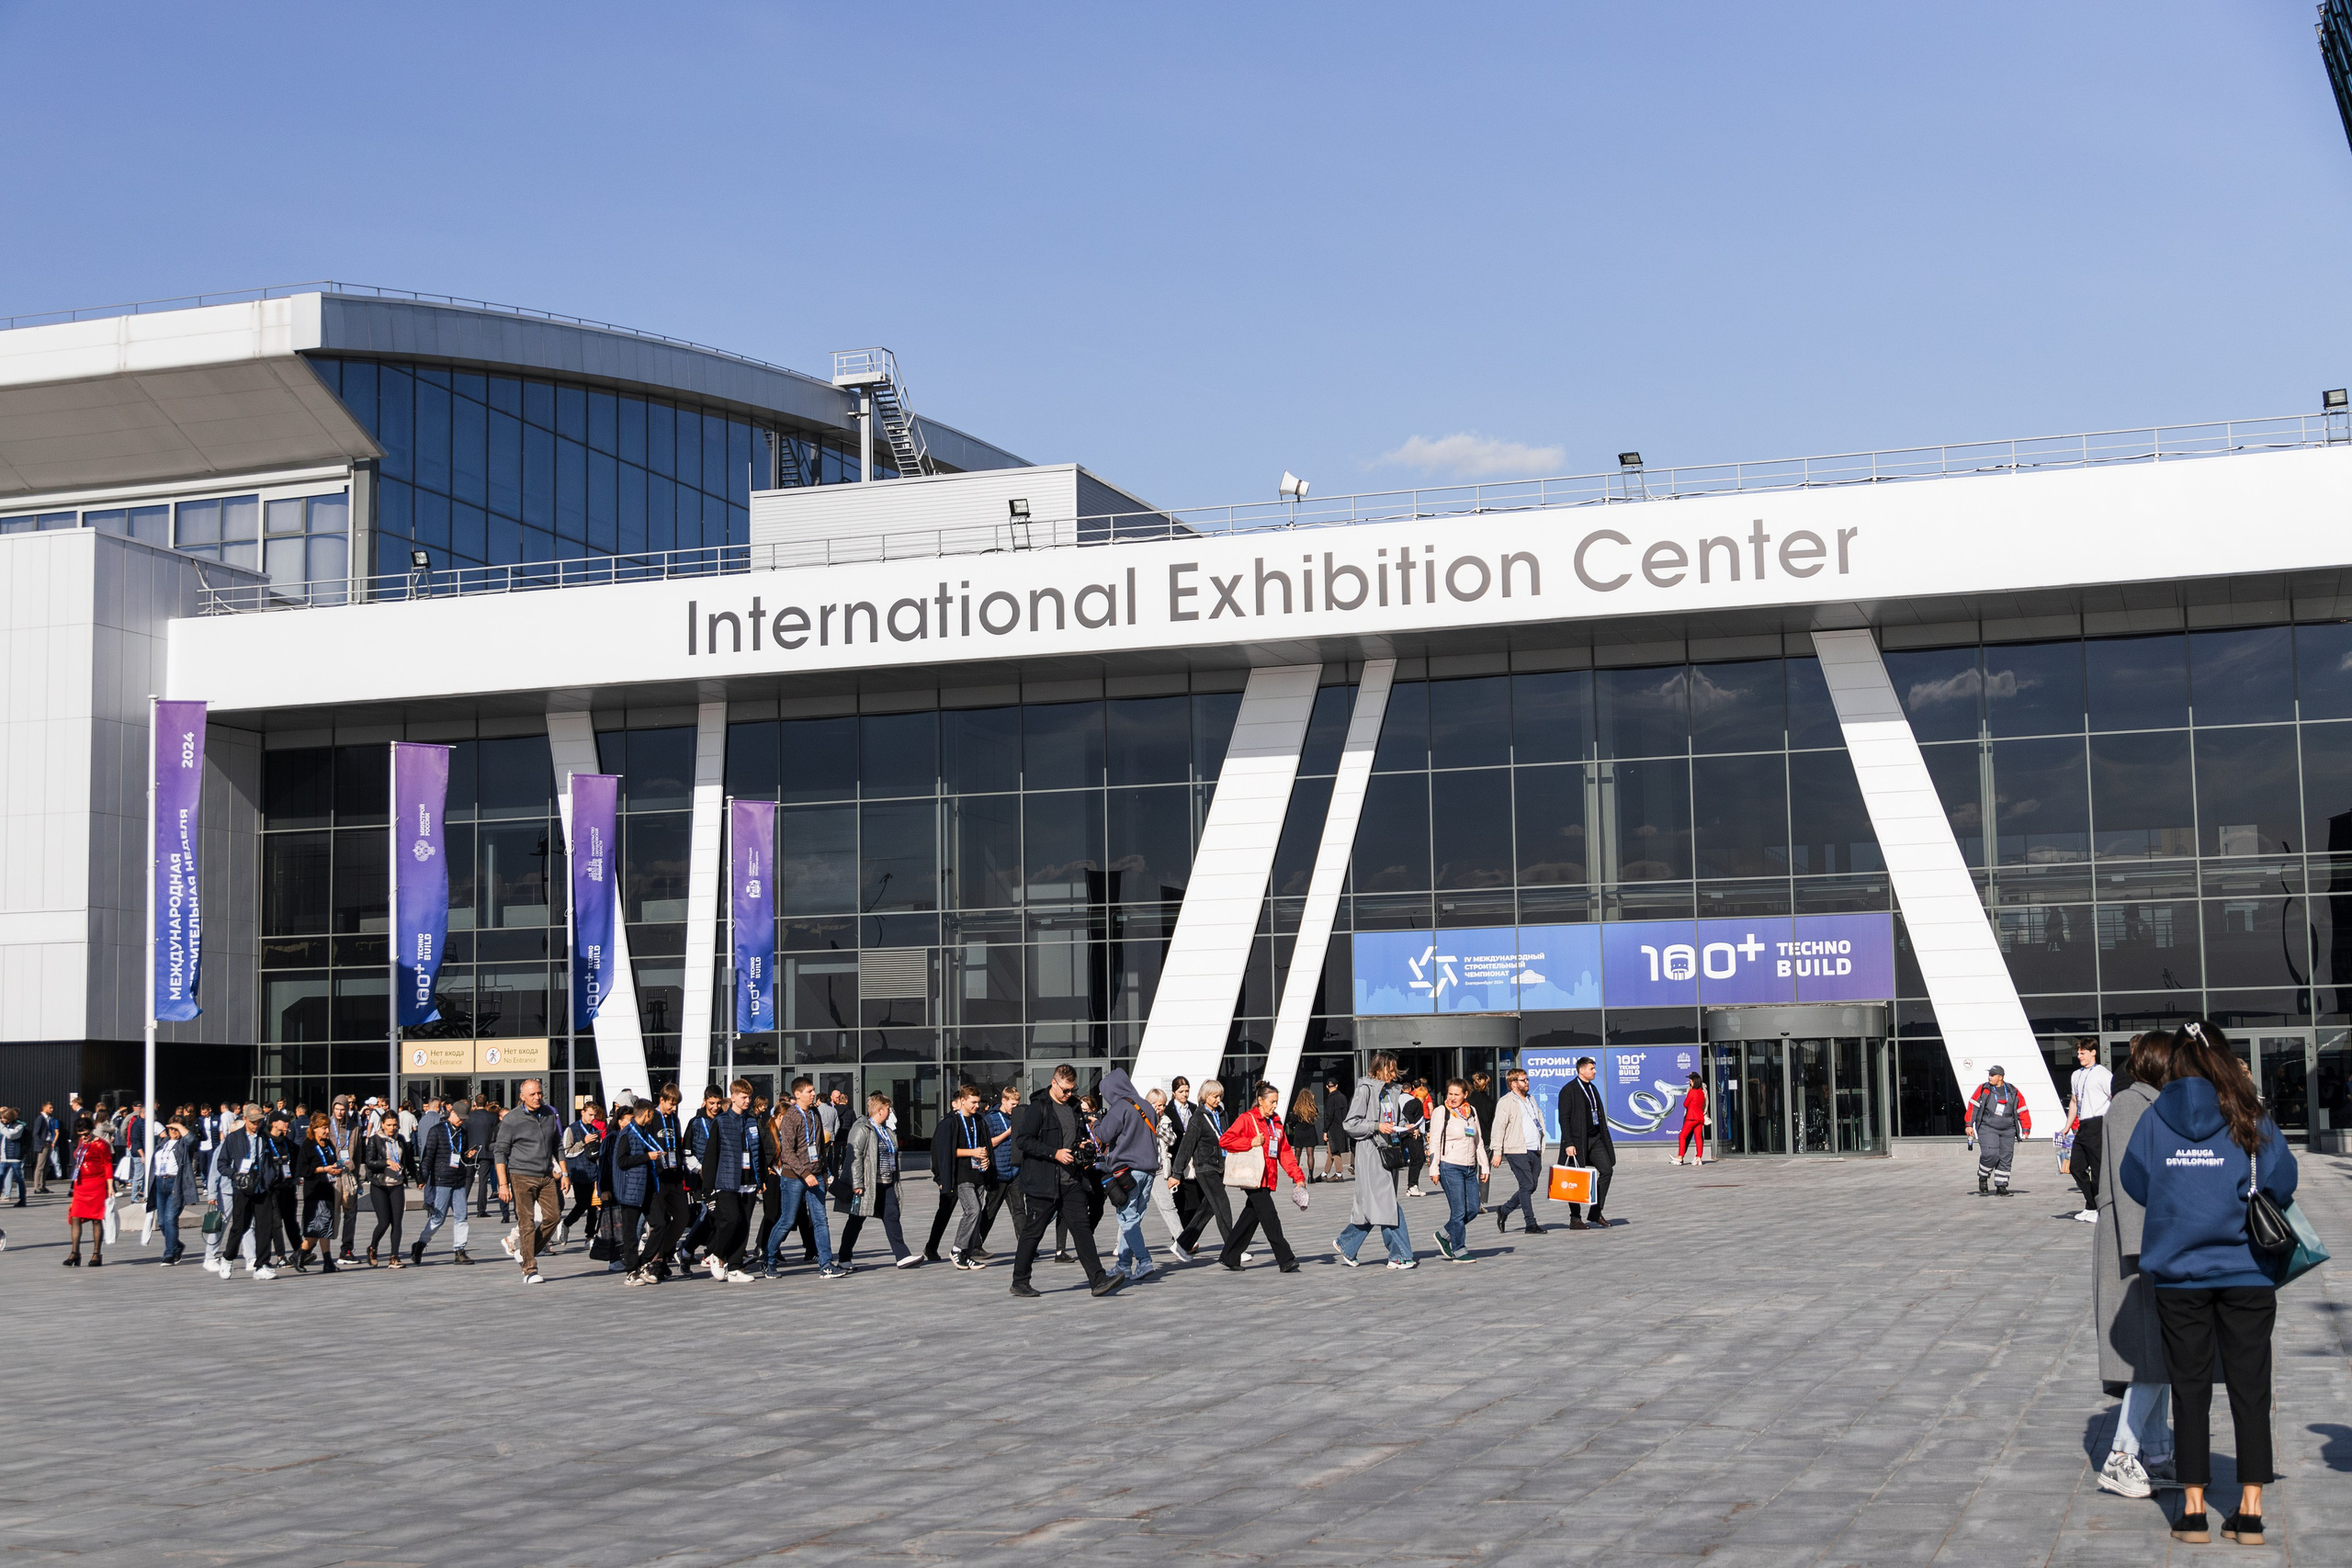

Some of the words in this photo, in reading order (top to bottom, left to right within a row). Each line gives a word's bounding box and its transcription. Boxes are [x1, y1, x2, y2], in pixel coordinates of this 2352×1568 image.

[688, 567, 1136, 656] International
[1170, 544, 1541, 622] Exhibition
[1573, 519, 1859, 593] Center
[182, 731, 195, 769] 2024
[179, 808, 194, 872] НЕДЕЛЯ
[169, 853, 184, 1000] МЕЖДУНАРОДНАЯ
[1776, 940, 1851, 956] TECHNO
[1464, 960, 1525, 970] СТРОИТЕЛЬНЫЙ
[1473, 952, 1545, 962] МЕЖДУНАРОДНЫЙ
[1776, 958, 1852, 977] BUILD
[1527, 1057, 1570, 1066] СТРОИМ
[1528, 1068, 1578, 1077] БУДУЩЕГ
[2166, 1158, 2225, 1166] DEVELOPMENT
